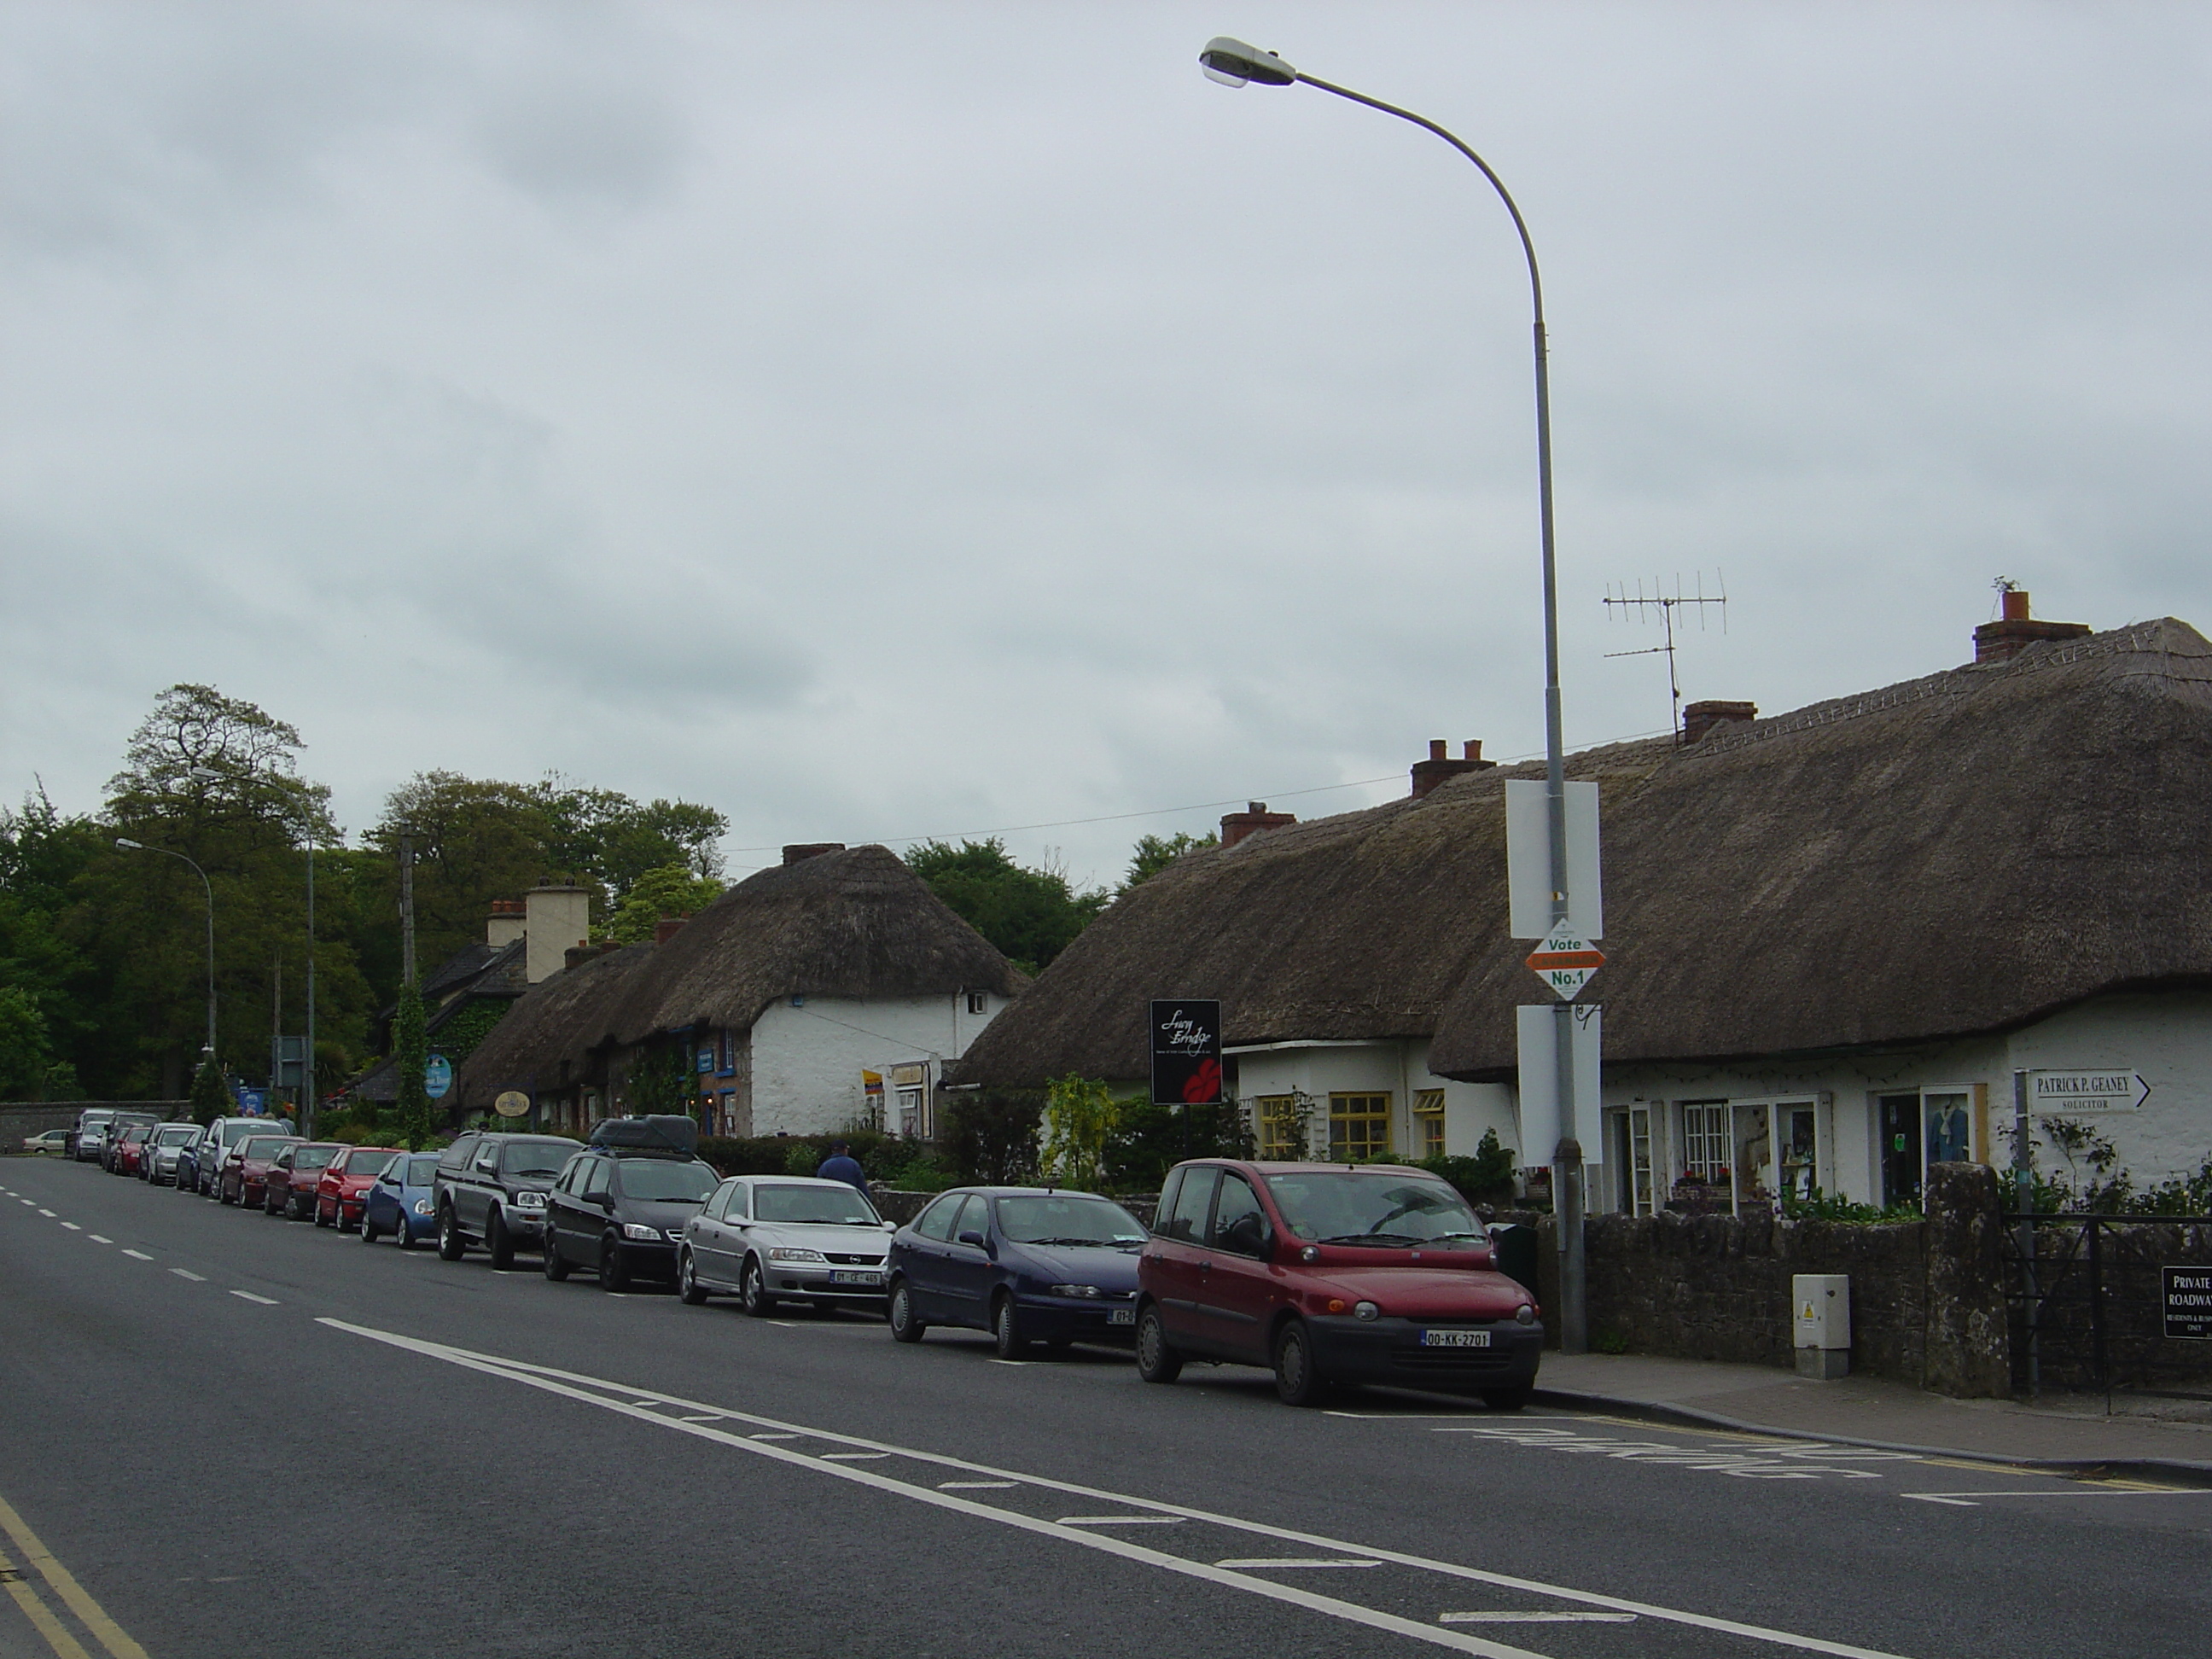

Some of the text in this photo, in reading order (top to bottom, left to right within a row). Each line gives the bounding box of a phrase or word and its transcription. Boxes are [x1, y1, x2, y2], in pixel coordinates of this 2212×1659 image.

[1549, 940, 1581, 950] Vote
[1551, 969, 1584, 985] No.1
[1161, 1010, 1193, 1035] Lucy
[2037, 1076, 2129, 1092] PATRICK P. GEANEY
[2062, 1099, 2109, 1109] SOLICITOR
[2173, 1275, 2211, 1289] PRIVATE
[1427, 1333, 1487, 1347] 00-KK-2701
[1429, 1428, 1883, 1479] PARKING
[1707, 1444, 1924, 1460] NO
